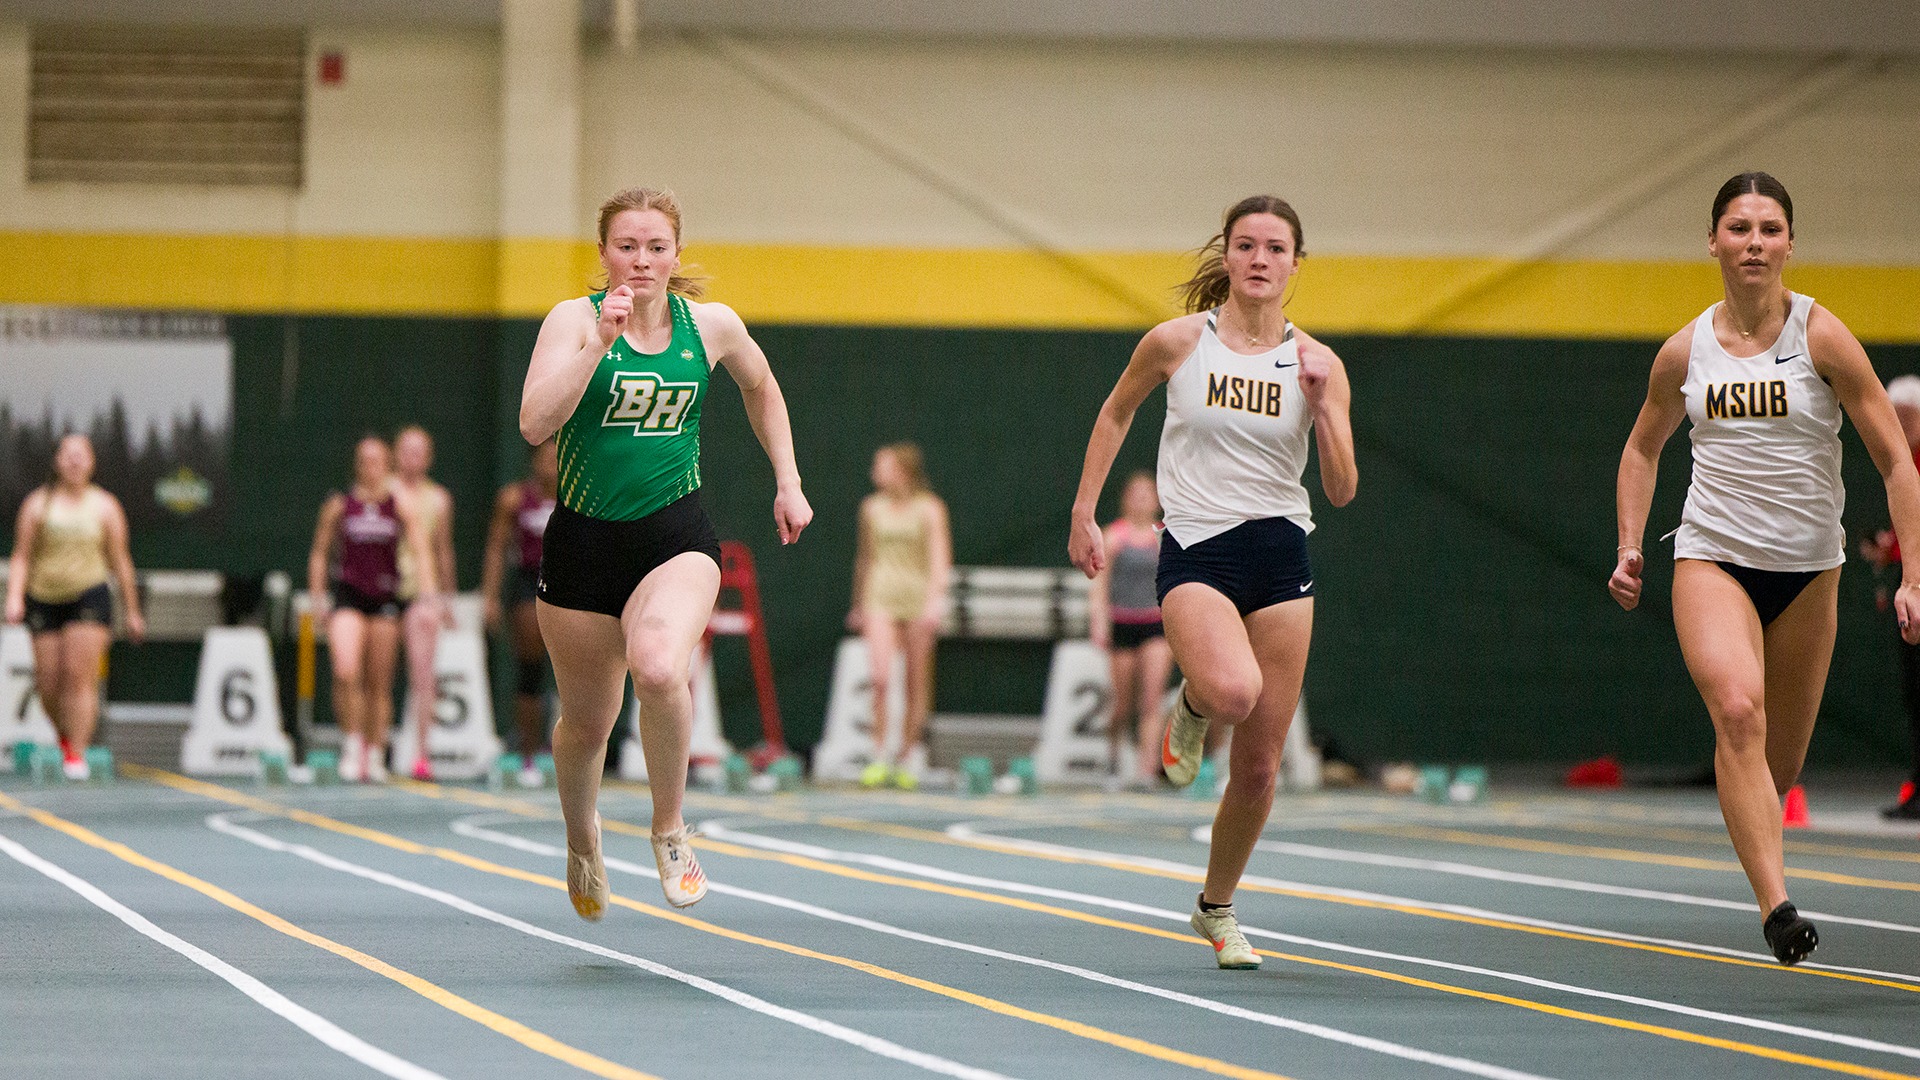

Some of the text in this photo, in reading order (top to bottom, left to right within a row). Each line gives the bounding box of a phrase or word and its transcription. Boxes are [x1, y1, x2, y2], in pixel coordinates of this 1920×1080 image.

[612, 379, 692, 429] BH
[1206, 372, 1282, 418] MSUB
[1705, 380, 1788, 420] MSUB
[220, 668, 255, 727] 6
[432, 672, 468, 730] 5
[1072, 681, 1115, 739] 2
